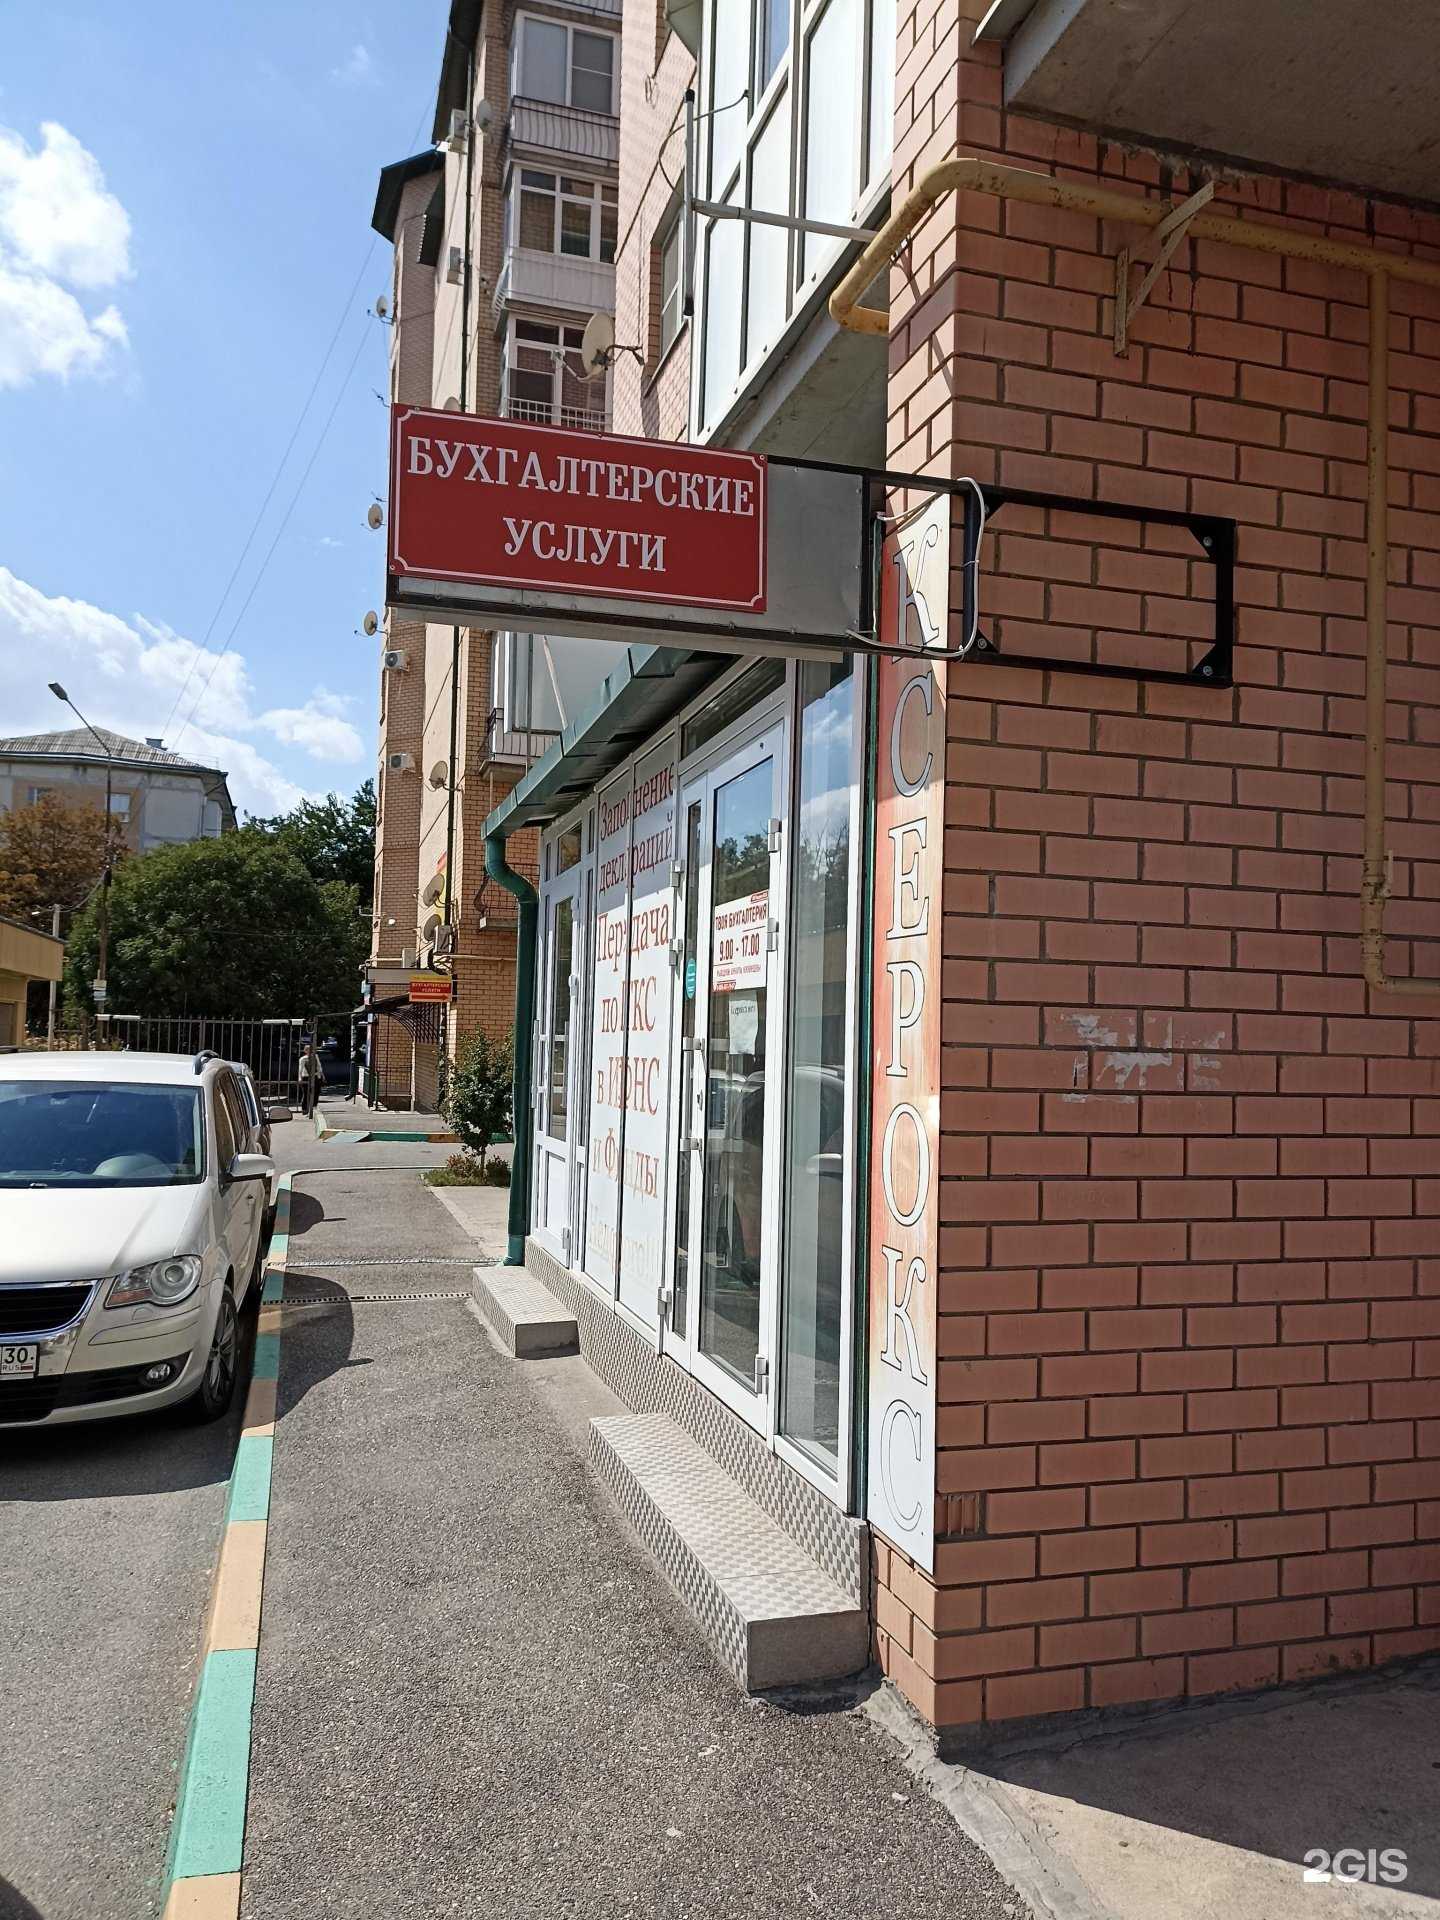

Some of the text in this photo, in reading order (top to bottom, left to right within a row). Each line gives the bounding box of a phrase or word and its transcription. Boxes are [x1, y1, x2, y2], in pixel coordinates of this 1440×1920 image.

[407, 436, 754, 516] БУХГАЛТЕРСКИЕ
[502, 517, 667, 572] УСЛУГИ
[597, 903, 669, 972] Пердача
[728, 903, 767, 928] БУХГАЛТЕРИЯ
[719, 939, 734, 961] 9.00
[741, 933, 760, 958] 17.00
[601, 997, 618, 1033] по
[880, 523, 939, 1532] КСЕРОКС
[4, 1347, 28, 1364] 30
